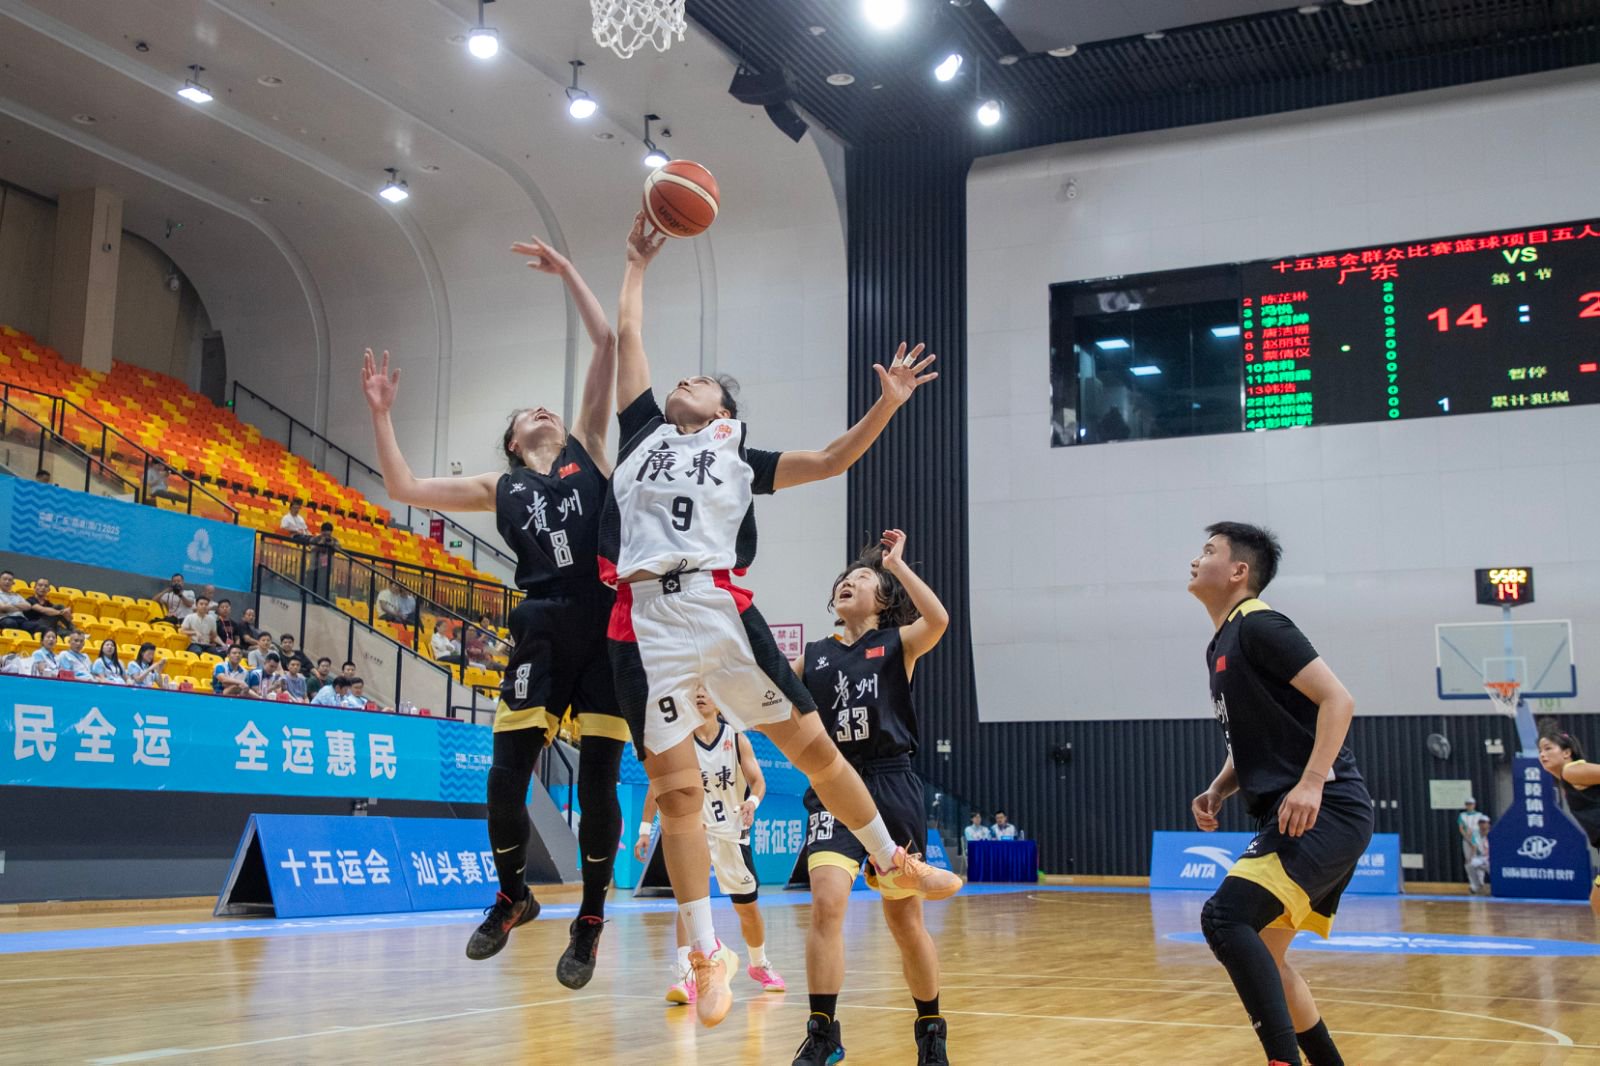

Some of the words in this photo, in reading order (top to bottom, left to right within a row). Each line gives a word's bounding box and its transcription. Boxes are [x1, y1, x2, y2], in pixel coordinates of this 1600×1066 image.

[1502, 246, 1538, 264] VS
[1337, 262, 1399, 285] 广东
[1428, 303, 1488, 332] 14
[1438, 397, 1450, 412] 1
[635, 441, 724, 486] 廣東
[671, 496, 694, 532] 9
[549, 529, 574, 568] 8
[1498, 583, 1518, 600] 14
[514, 663, 531, 699] 8
[658, 696, 678, 723] 9
[836, 706, 870, 742] 33
[14, 703, 171, 767] 民全运
[235, 720, 397, 780] 全运惠民
[711, 800, 726, 822] 2
[807, 811, 834, 845] 33
[755, 819, 802, 855] 新征程
[280, 848, 391, 887] 十五运会
[411, 850, 500, 887] 汕头赛区
[1180, 863, 1216, 878] ANTA
